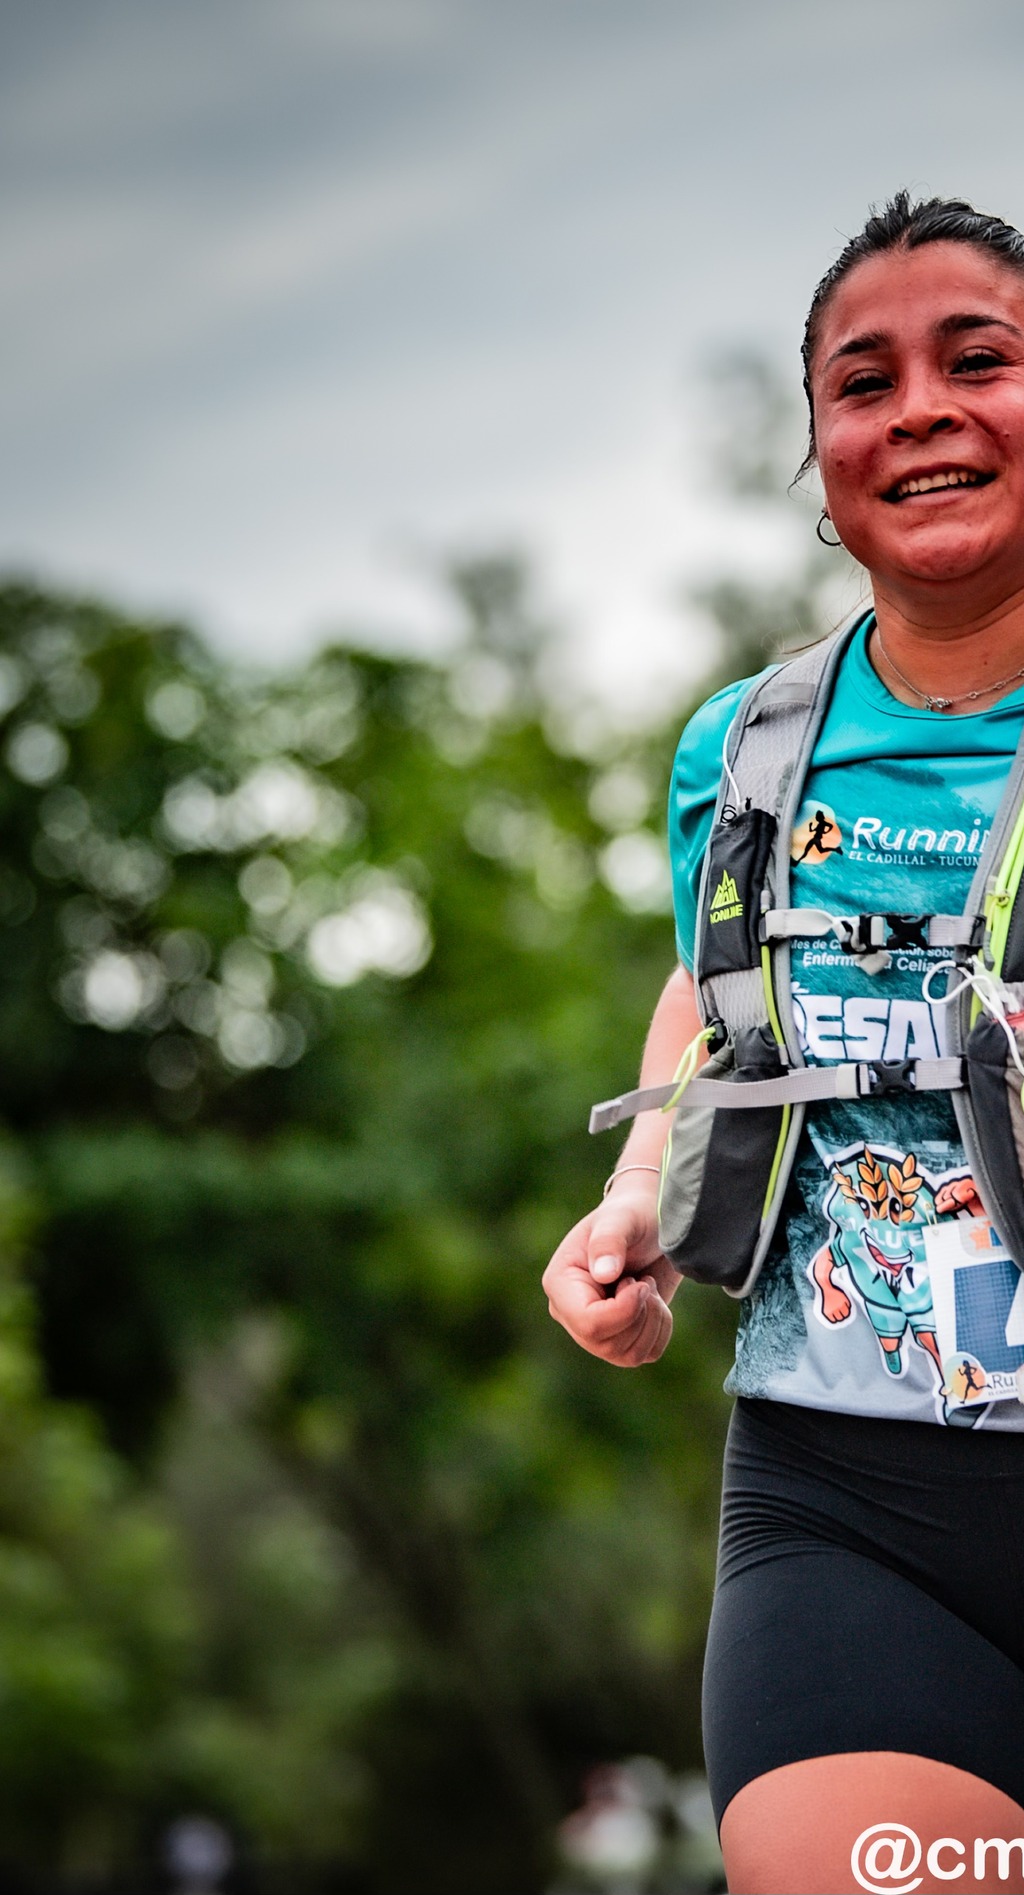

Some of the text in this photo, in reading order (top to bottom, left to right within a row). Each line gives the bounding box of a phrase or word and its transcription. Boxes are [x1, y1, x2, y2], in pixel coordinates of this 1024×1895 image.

[848, 850, 864, 861] EL
[866, 852, 926, 866] CADILLAL
[812, 938, 828, 950] de
[927, 947, 955, 959] sobr
[792, 994, 947, 1061] ESA
